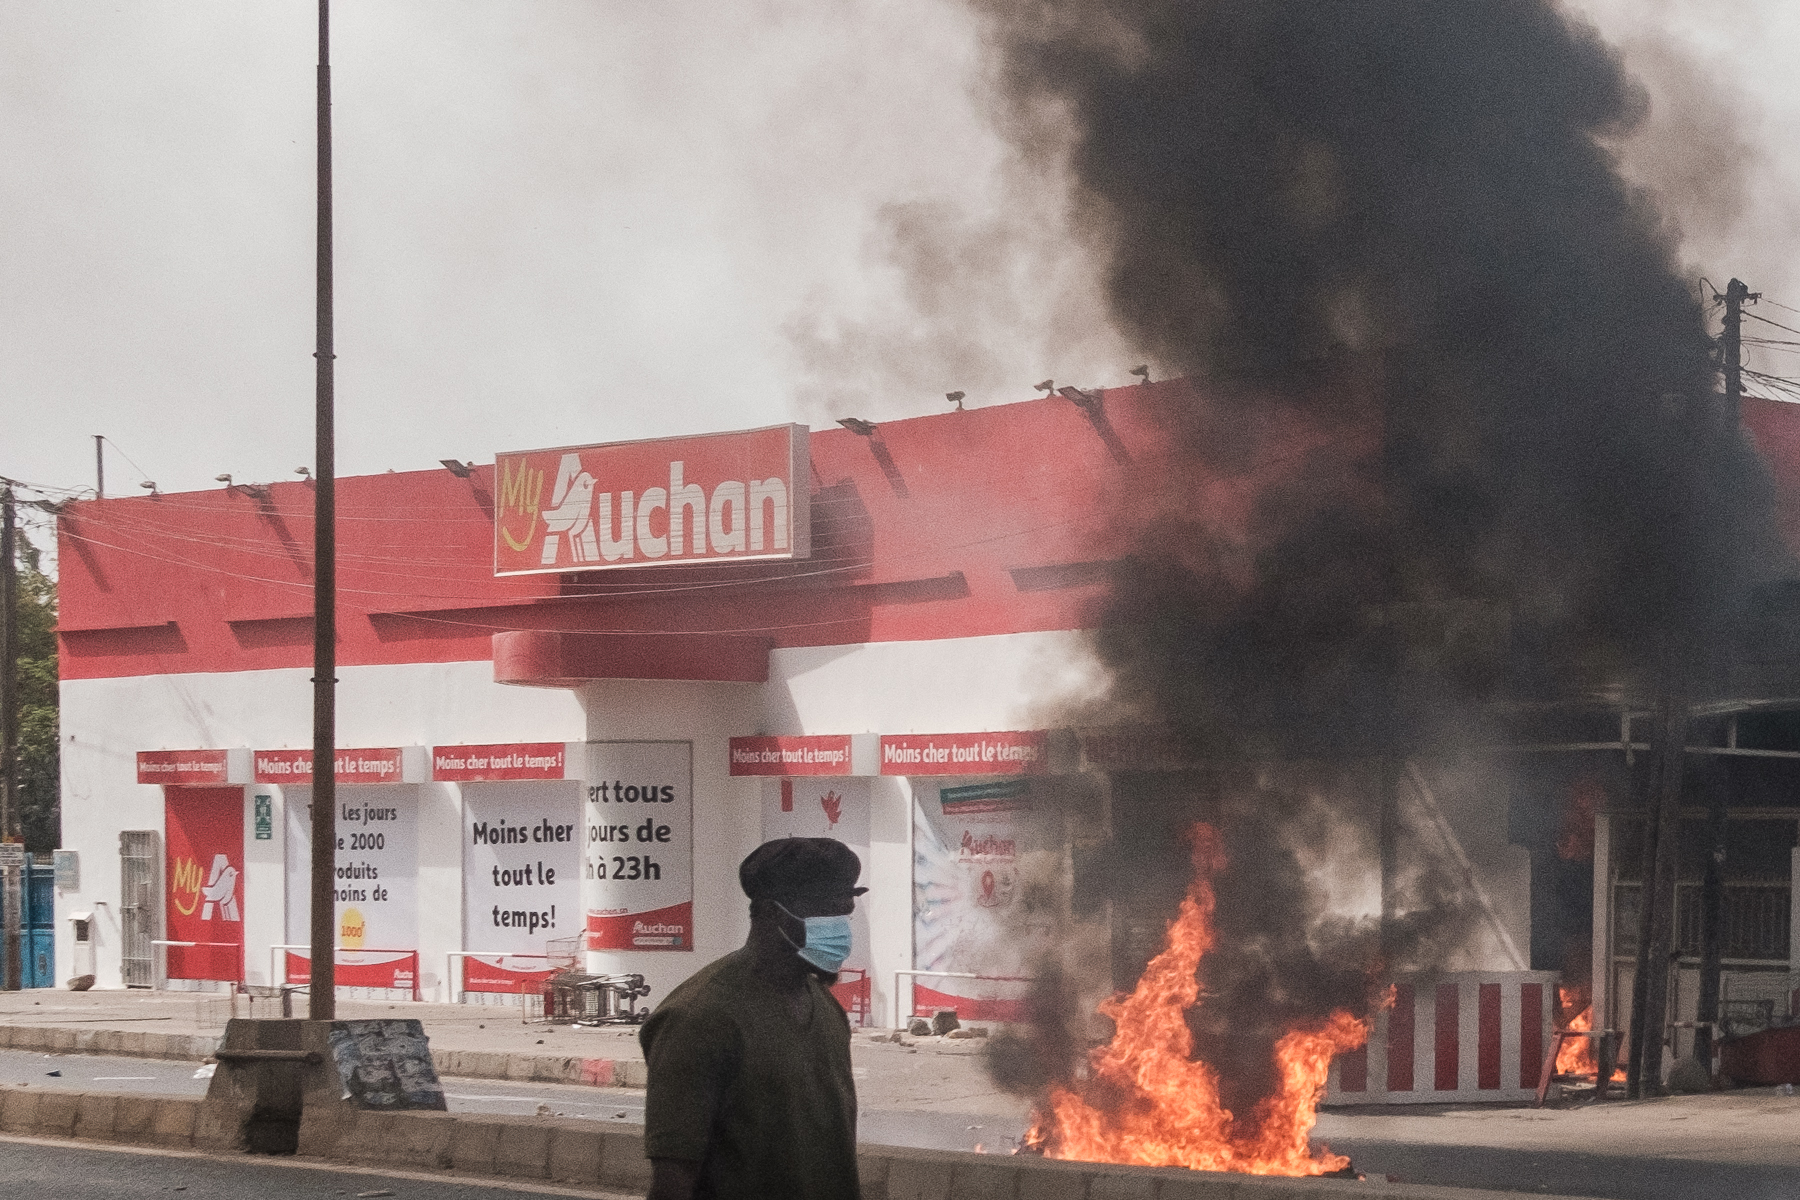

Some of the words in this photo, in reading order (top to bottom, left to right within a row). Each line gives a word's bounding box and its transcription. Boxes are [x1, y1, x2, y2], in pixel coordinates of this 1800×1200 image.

[500, 457, 544, 552] My
[541, 453, 789, 565] Auchan
[436, 755, 465, 770] Moins
[467, 754, 488, 769] cher
[490, 755, 512, 769] tout
[513, 753, 524, 768] le
[733, 747, 760, 763] Moins
[761, 747, 781, 763] cher
[782, 748, 803, 763] tout
[804, 747, 814, 763] le
[884, 742, 921, 763] Moins
[923, 743, 949, 763] cher
[952, 743, 980, 762] tout
[982, 741, 995, 762] le
[257, 757, 291, 774] Moins
[293, 757, 313, 774] che
[345, 756, 357, 773] le
[613, 780, 675, 803] tous
[342, 803, 360, 821] les
[363, 802, 397, 826] jours
[350, 832, 385, 850] 2000
[473, 819, 528, 845] Moins
[533, 818, 573, 843] cher
[587, 816, 630, 848] jours
[636, 818, 672, 843] de
[492, 864, 533, 886] tout
[537, 861, 556, 885] le
[597, 855, 607, 880] à
[612, 855, 661, 880] 23h
[172, 856, 203, 916] My
[373, 884, 388, 901] de
[492, 905, 556, 935] temps!
[633, 920, 684, 934] Auchan
